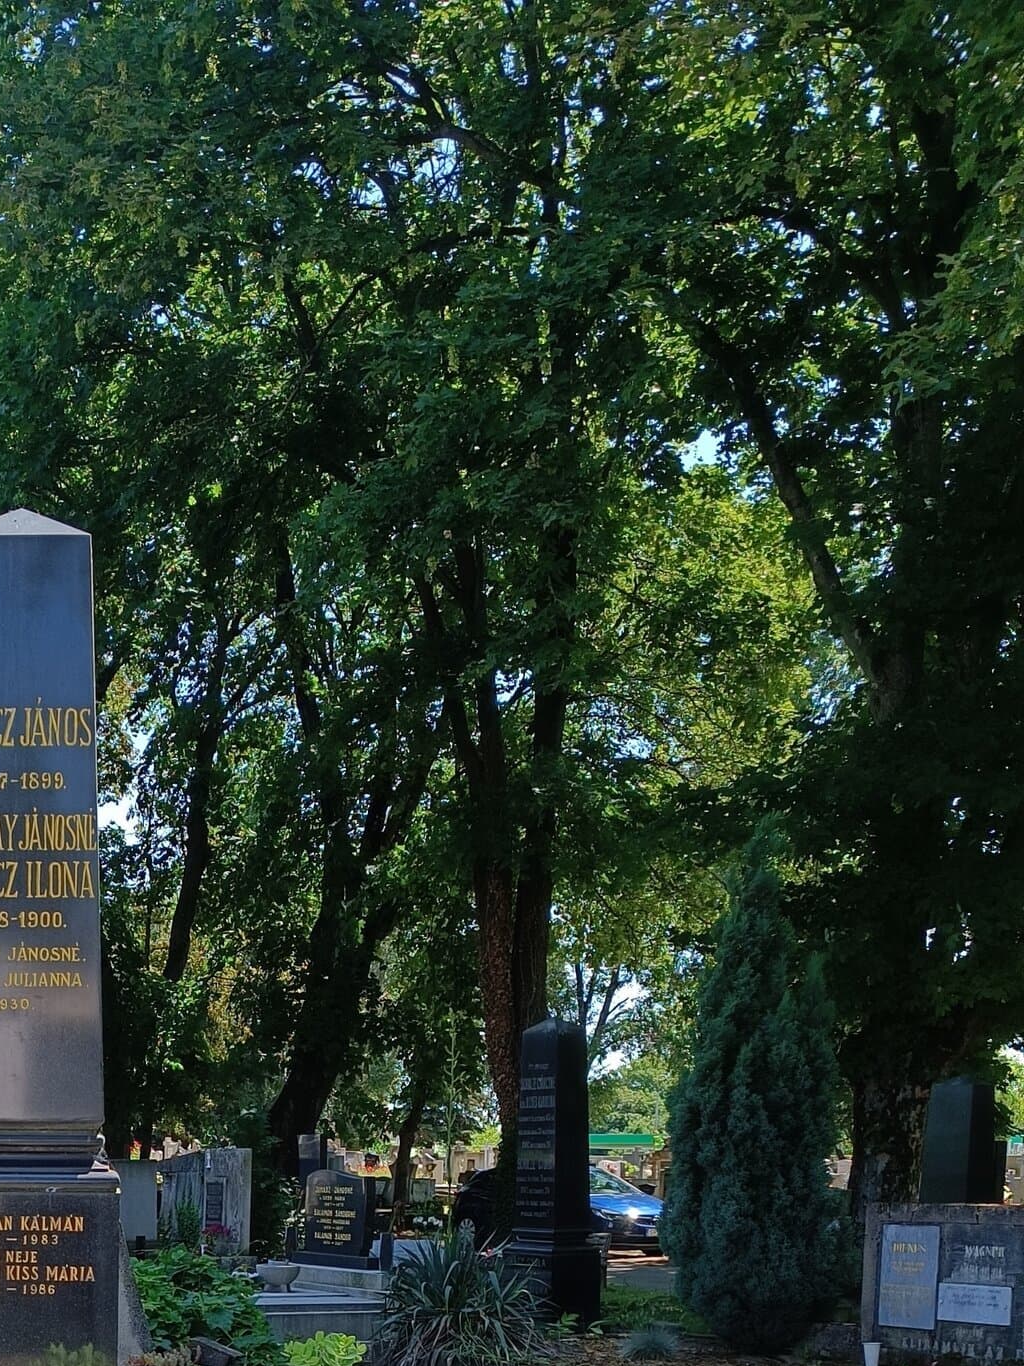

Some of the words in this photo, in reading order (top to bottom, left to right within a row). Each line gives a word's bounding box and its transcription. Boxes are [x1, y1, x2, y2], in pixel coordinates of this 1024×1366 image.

[20, 697, 92, 747] JÁNOS
[19, 808, 96, 851] JÁNOSNÉ
[26, 861, 95, 898] ILONA
[20, 1214, 84, 1232] KÁLMÁN
[23, 1234, 59, 1245] 1983
[6, 1265, 39, 1281] KISS
[46, 1264, 95, 1282] MÁRIA
[23, 1284, 56, 1295] 1986
